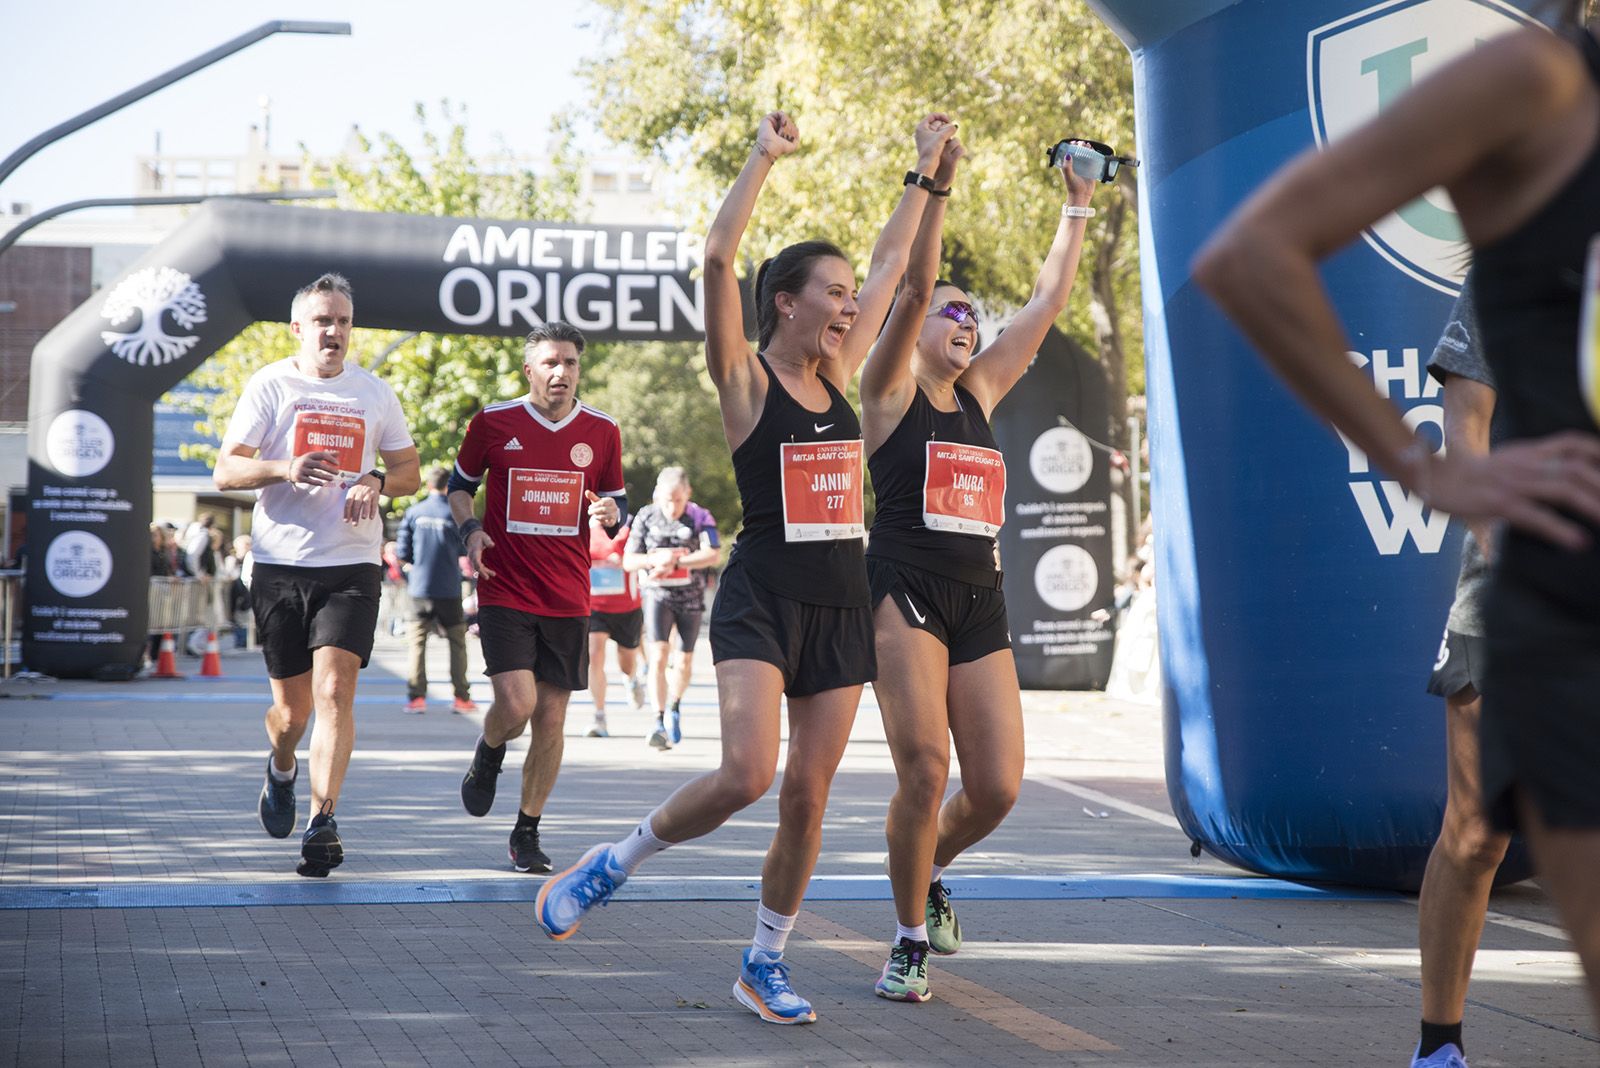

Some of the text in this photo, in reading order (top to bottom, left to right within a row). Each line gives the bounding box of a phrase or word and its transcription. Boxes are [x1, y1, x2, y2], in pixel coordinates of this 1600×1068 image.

[443, 224, 704, 270] AMETLLER
[439, 267, 705, 332] ORIGEN
[318, 404, 339, 412] SANT
[340, 406, 367, 416] CUGAT
[307, 432, 354, 448] CHRISTIAN
[792, 453, 815, 462] MITJA
[816, 452, 837, 461] SANT
[937, 451, 957, 460] MITJA
[958, 454, 974, 463] SANT
[974, 456, 994, 465] CUGAT
[953, 473, 984, 492] LAURA
[522, 490, 570, 504] JOHANNES
[827, 495, 845, 509] 277
[539, 505, 550, 516] 211
